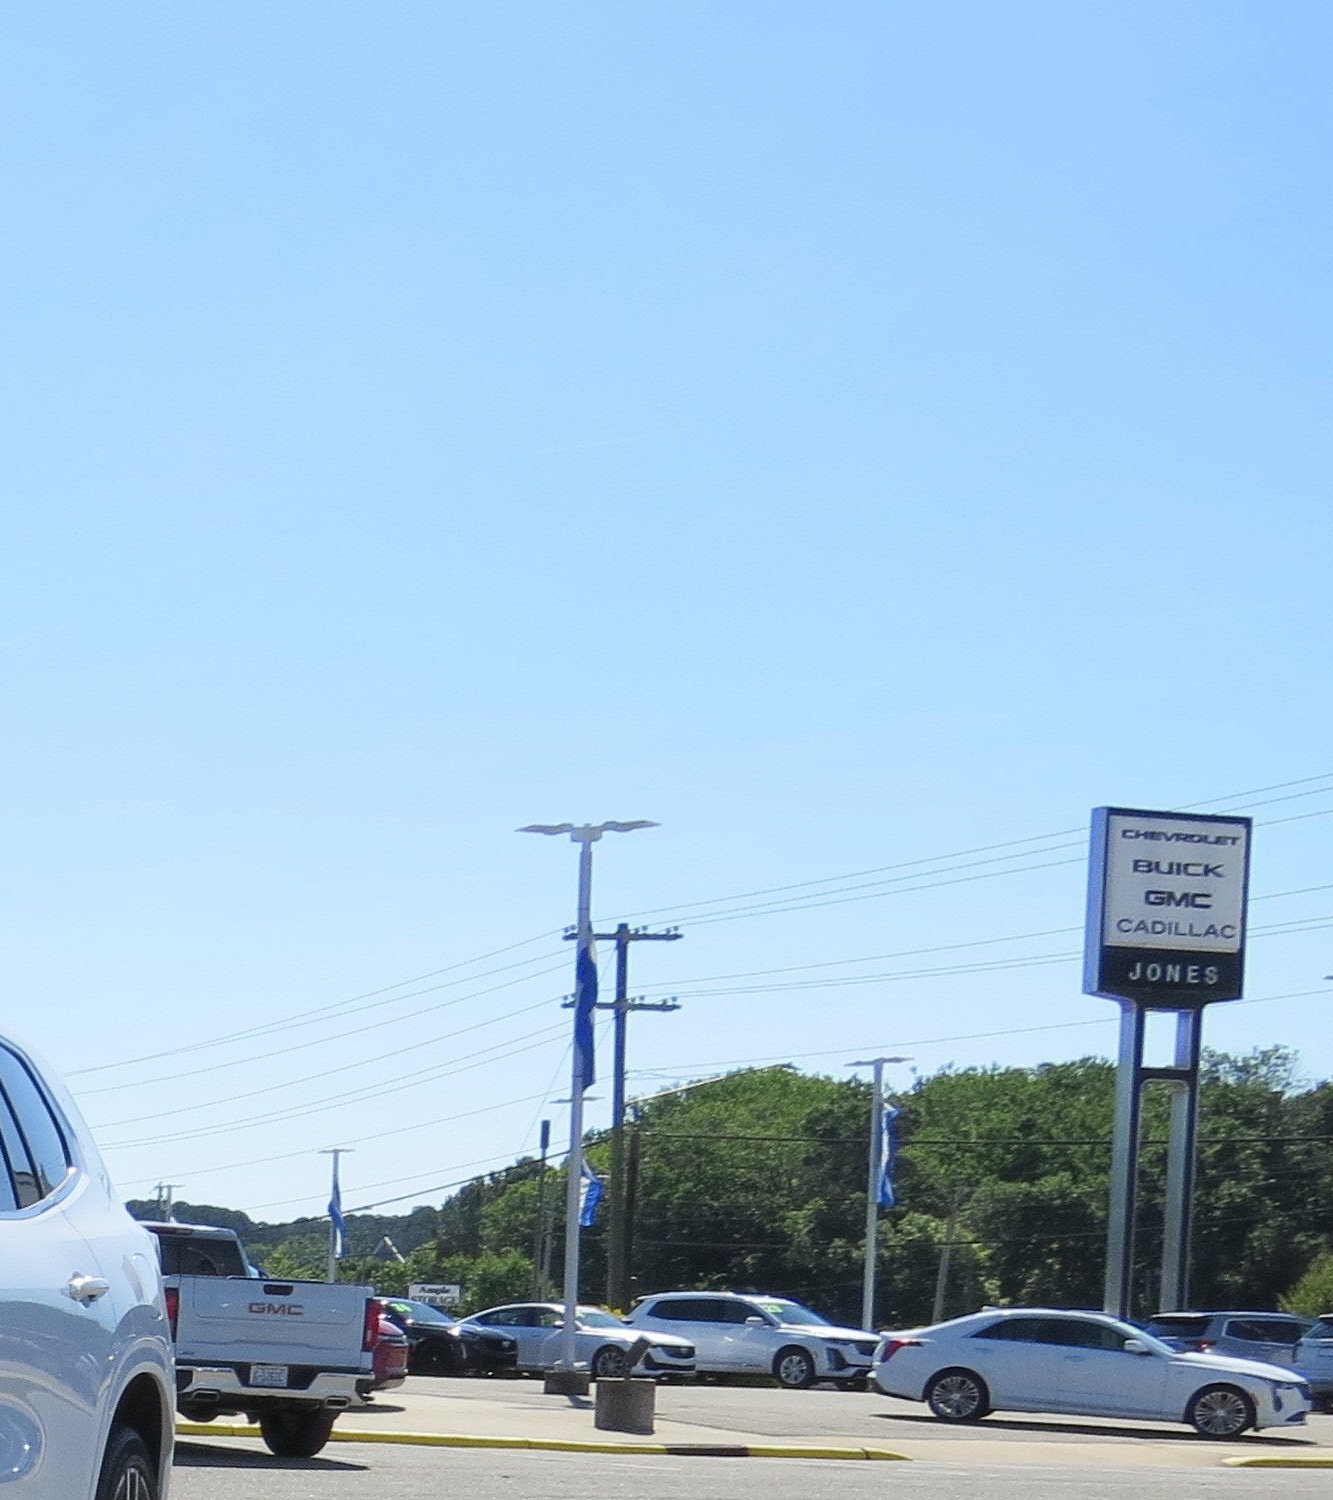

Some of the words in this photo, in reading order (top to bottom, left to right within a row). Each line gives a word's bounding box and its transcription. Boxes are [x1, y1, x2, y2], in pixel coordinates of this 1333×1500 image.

[1121, 829, 1240, 846] CHEVROLET
[1133, 859, 1225, 878] BUICK
[1144, 890, 1212, 909] GMC
[1117, 918, 1236, 938] CADILLAC
[1129, 962, 1219, 985] JONES
[248, 1302, 304, 1316] GMC
